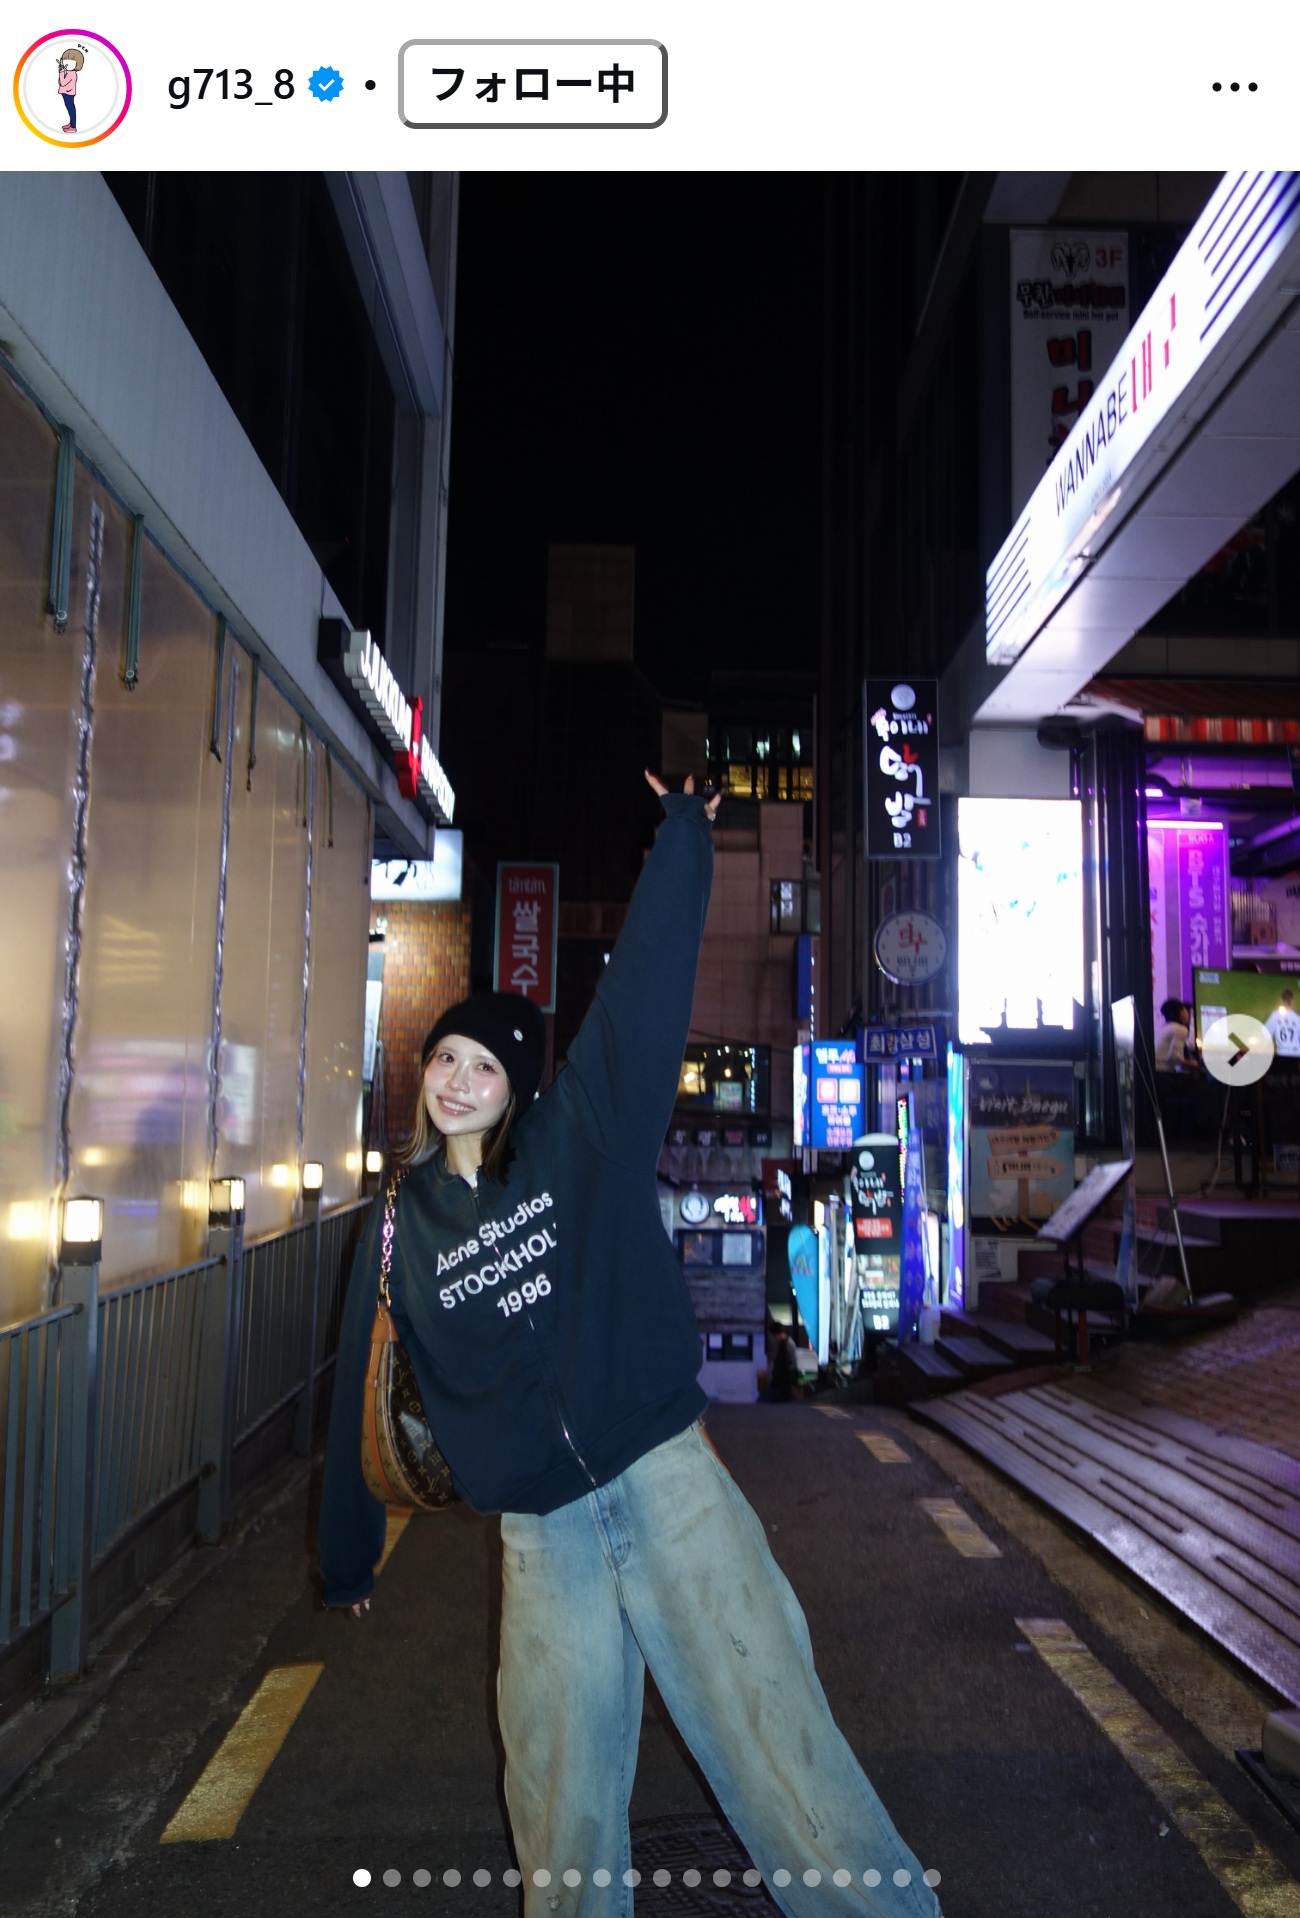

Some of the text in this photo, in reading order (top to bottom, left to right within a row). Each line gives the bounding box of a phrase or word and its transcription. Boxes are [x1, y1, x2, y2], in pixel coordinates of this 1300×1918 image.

[1095, 246, 1123, 269] 3F
[1023, 310, 1119, 323] Self-service mini hot pot
[1054, 370, 1128, 518] WANNABE
[511, 900, 542, 997] 쌀국수
[1279, 1028, 1295, 1042] 67
[979, 1094, 1069, 1122] Visit Daegu
[436, 1192, 553, 1276] Acne Studios
[439, 1222, 557, 1309] STOCKHOL
[497, 1273, 552, 1318] 1996
